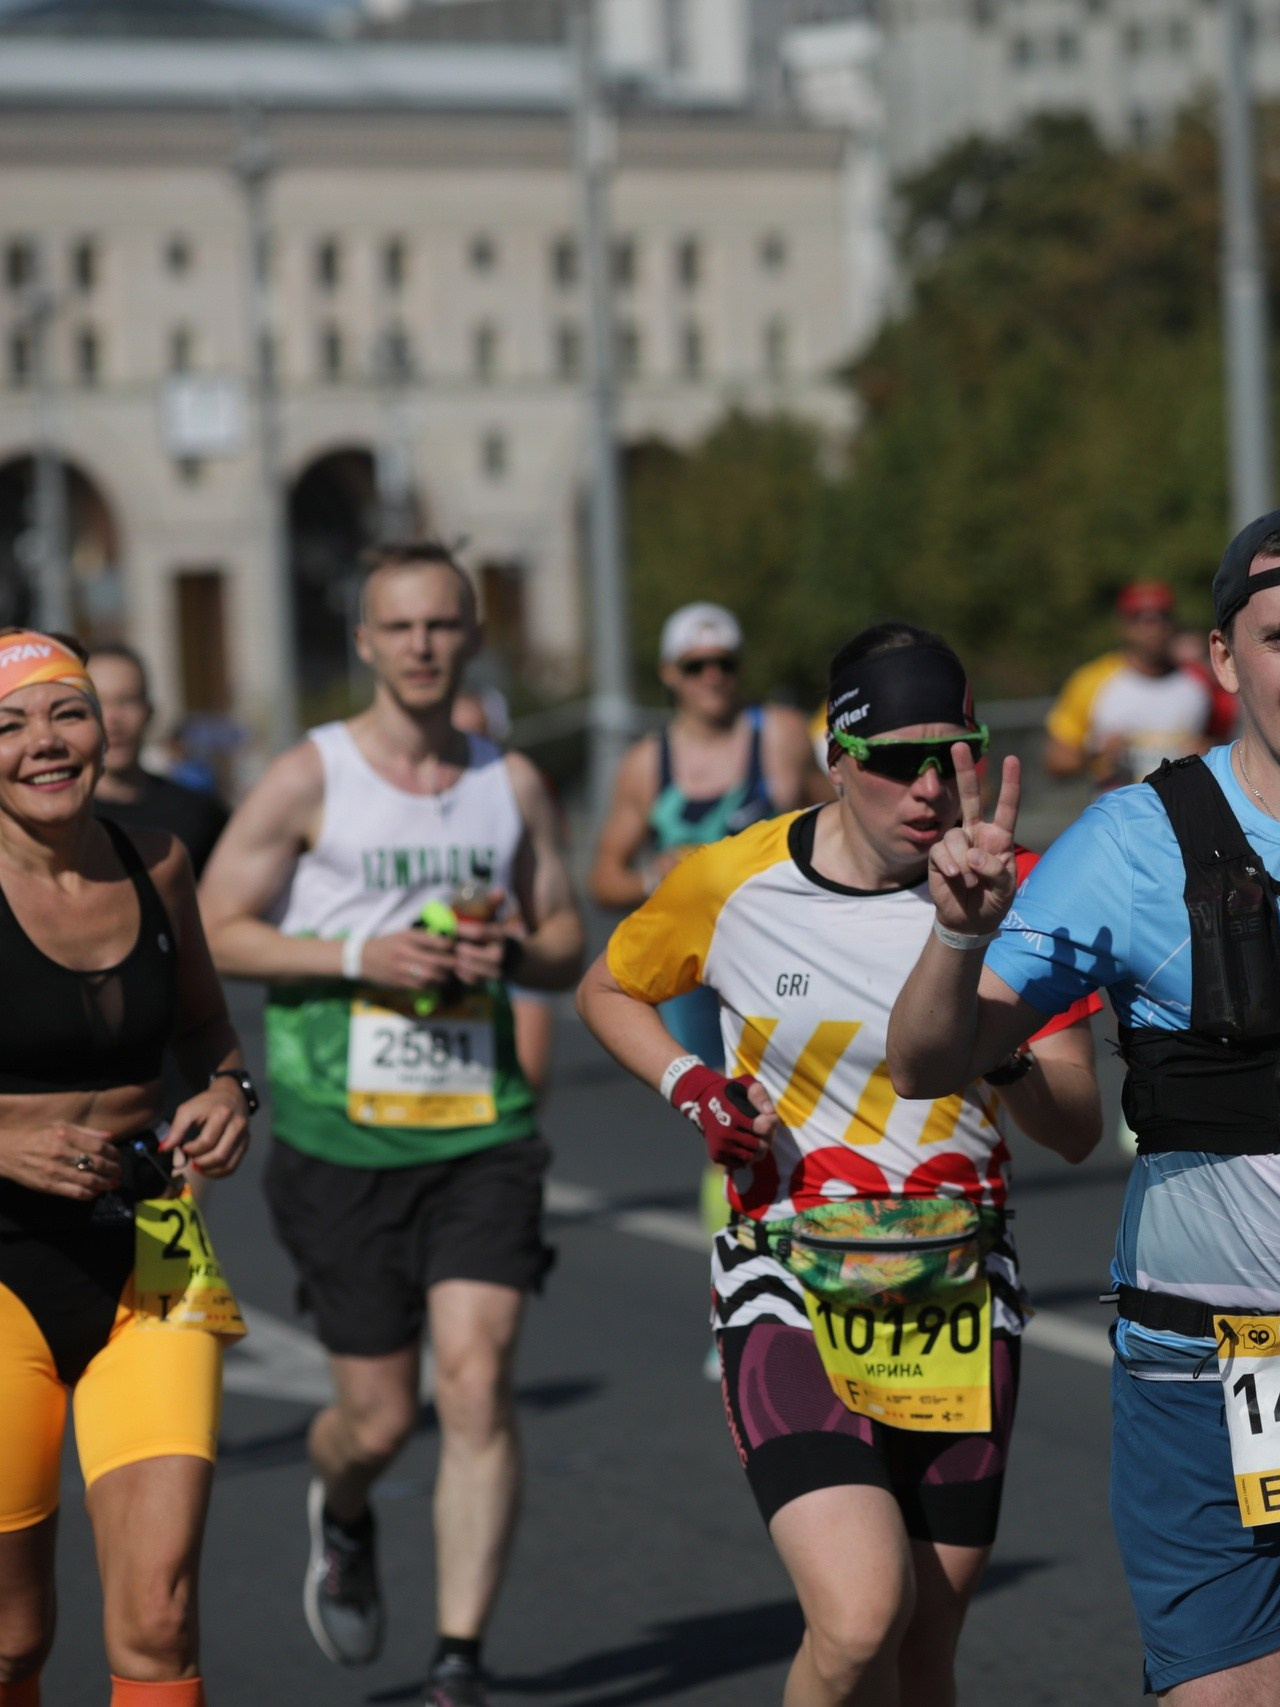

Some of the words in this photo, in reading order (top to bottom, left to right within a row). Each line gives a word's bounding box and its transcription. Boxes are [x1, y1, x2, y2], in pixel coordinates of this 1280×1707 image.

[776, 973, 810, 997] GRi
[373, 1027, 472, 1068] 2581
[817, 1301, 981, 1356] 10190
[864, 1363, 924, 1377] ИРИНА
